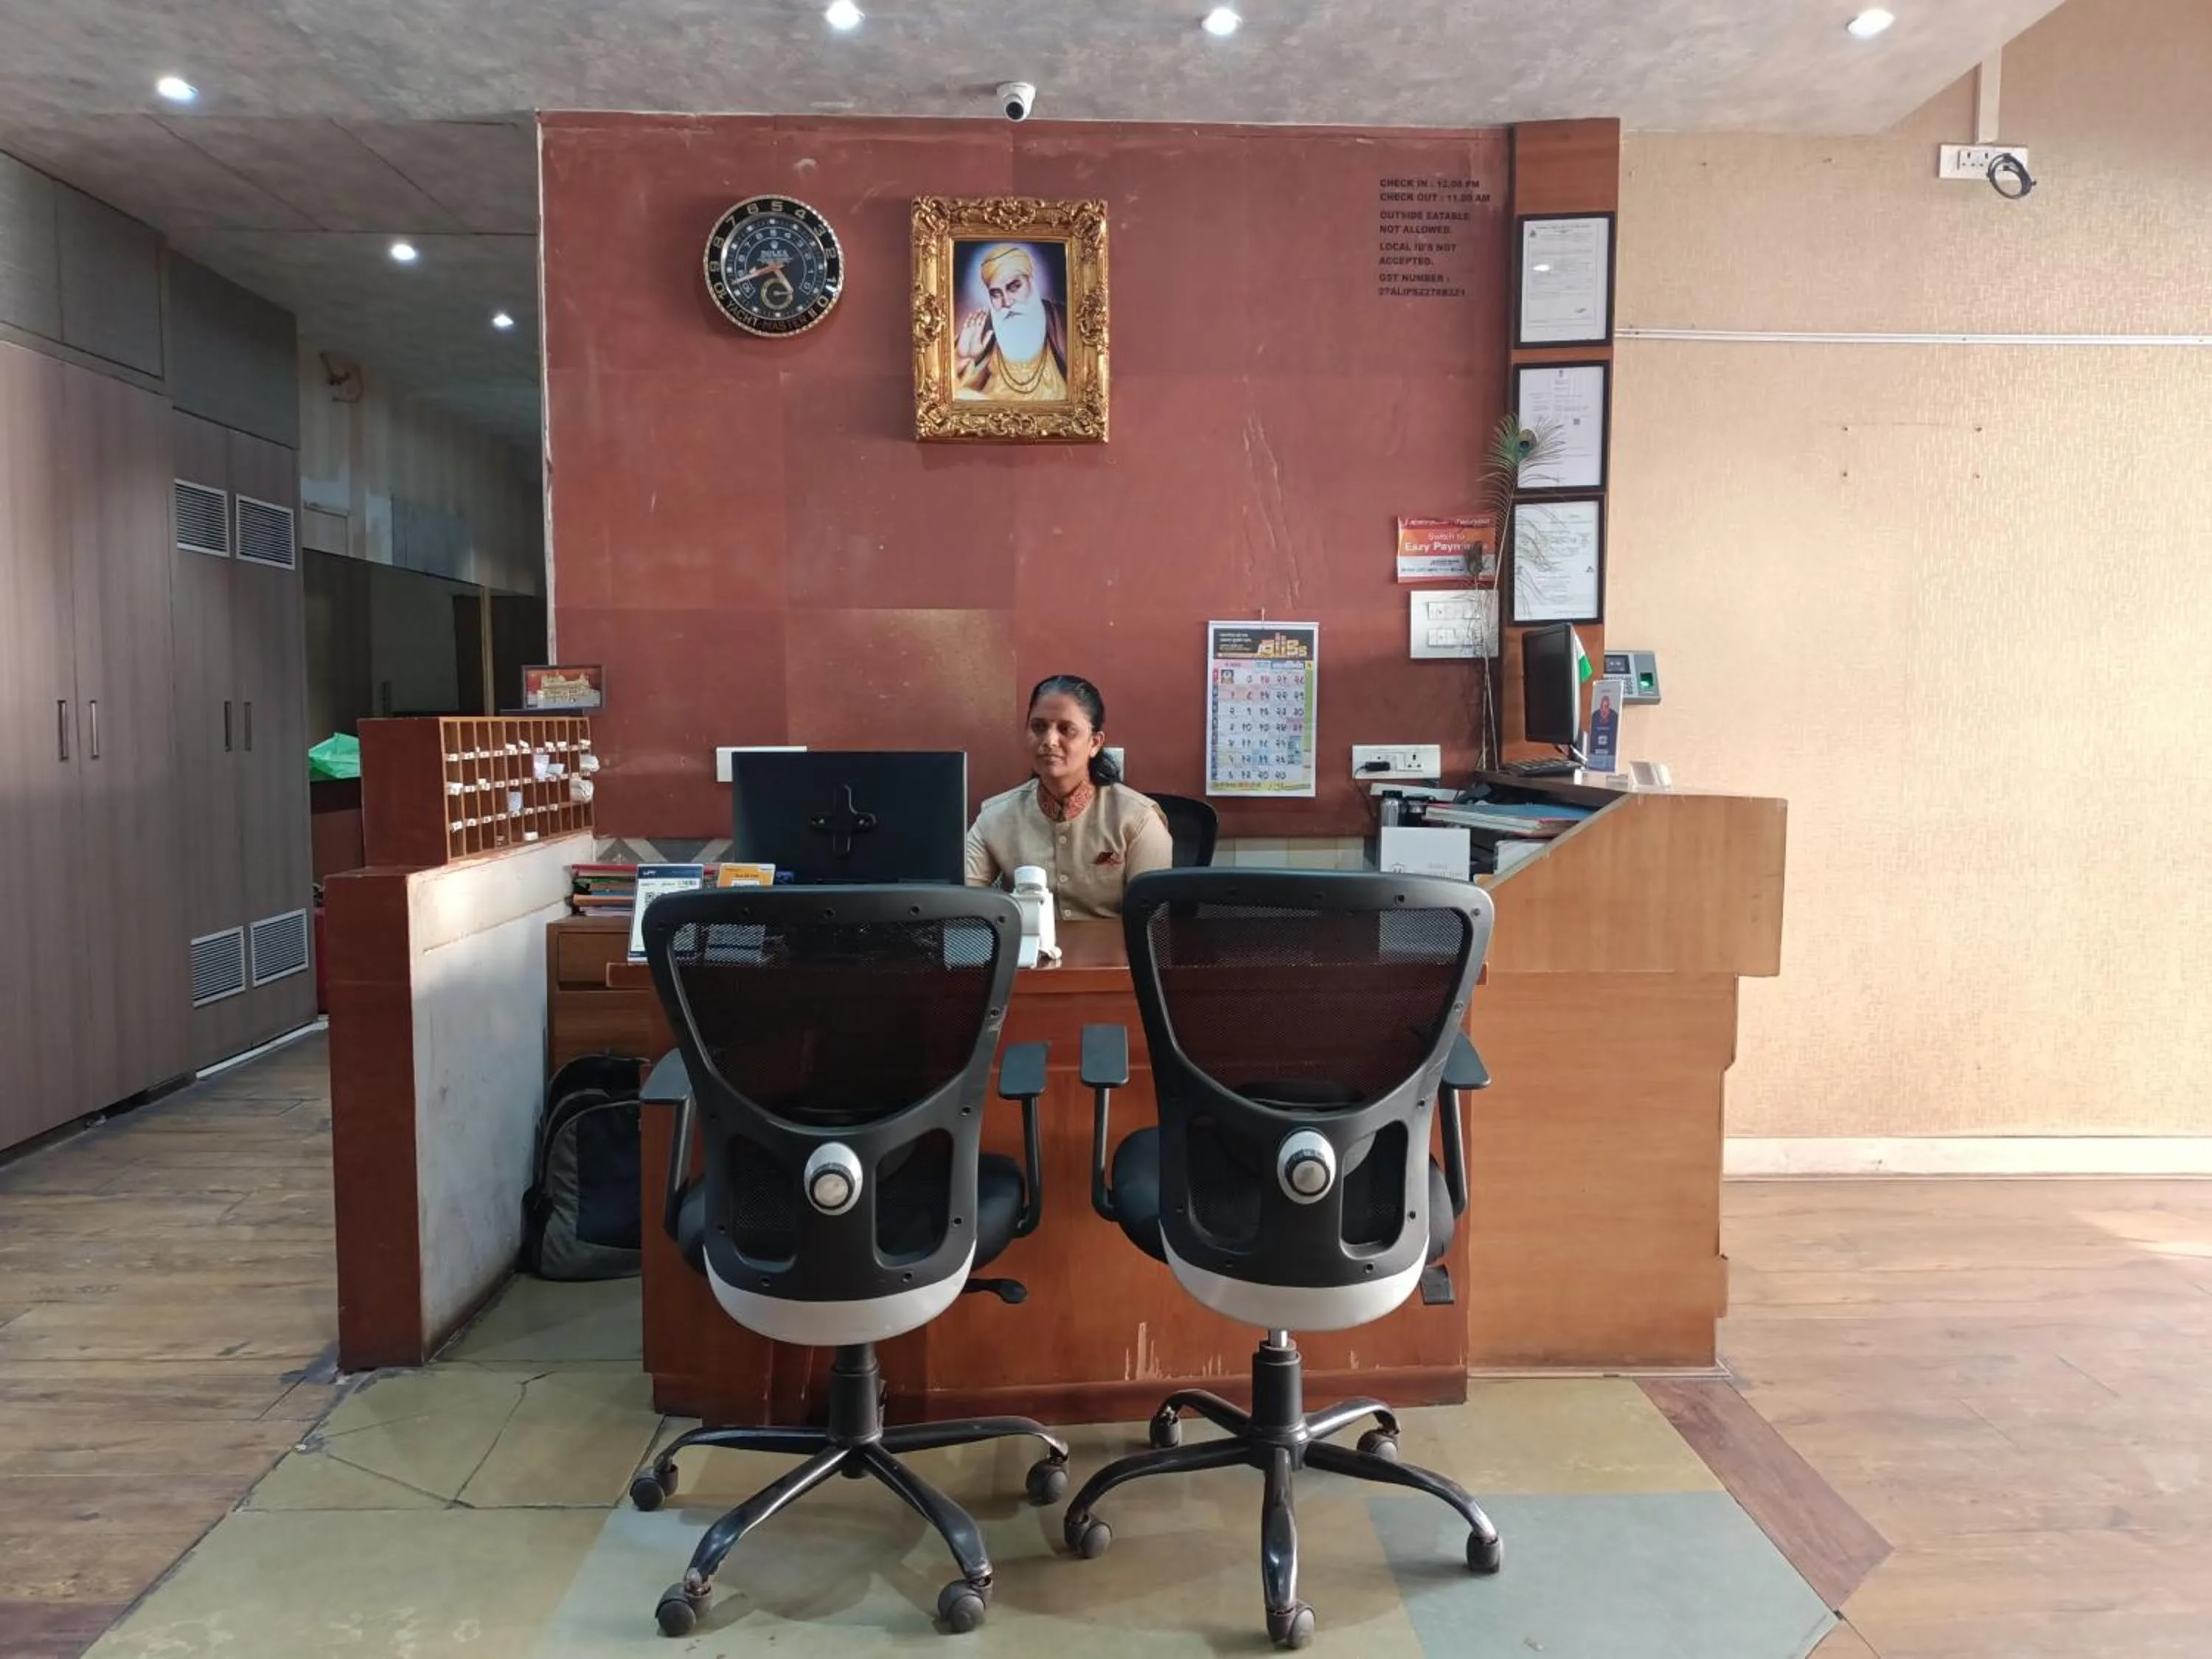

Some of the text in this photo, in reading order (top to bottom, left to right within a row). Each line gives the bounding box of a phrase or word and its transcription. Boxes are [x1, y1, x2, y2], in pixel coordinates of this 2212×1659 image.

[1380, 179, 1413, 187] CHECK
[1380, 193, 1413, 201] CHECK
[1417, 193, 1437, 201] OUT
[1380, 212, 1470, 220] OUTSIDE EATABLE
[1380, 225, 1401, 234] NOT
[1380, 243, 1411, 251] LOCAL
[1436, 243, 1456, 252] NOT
[1380, 274, 1399, 282] GST
[1402, 274, 1444, 282] NUMBER
